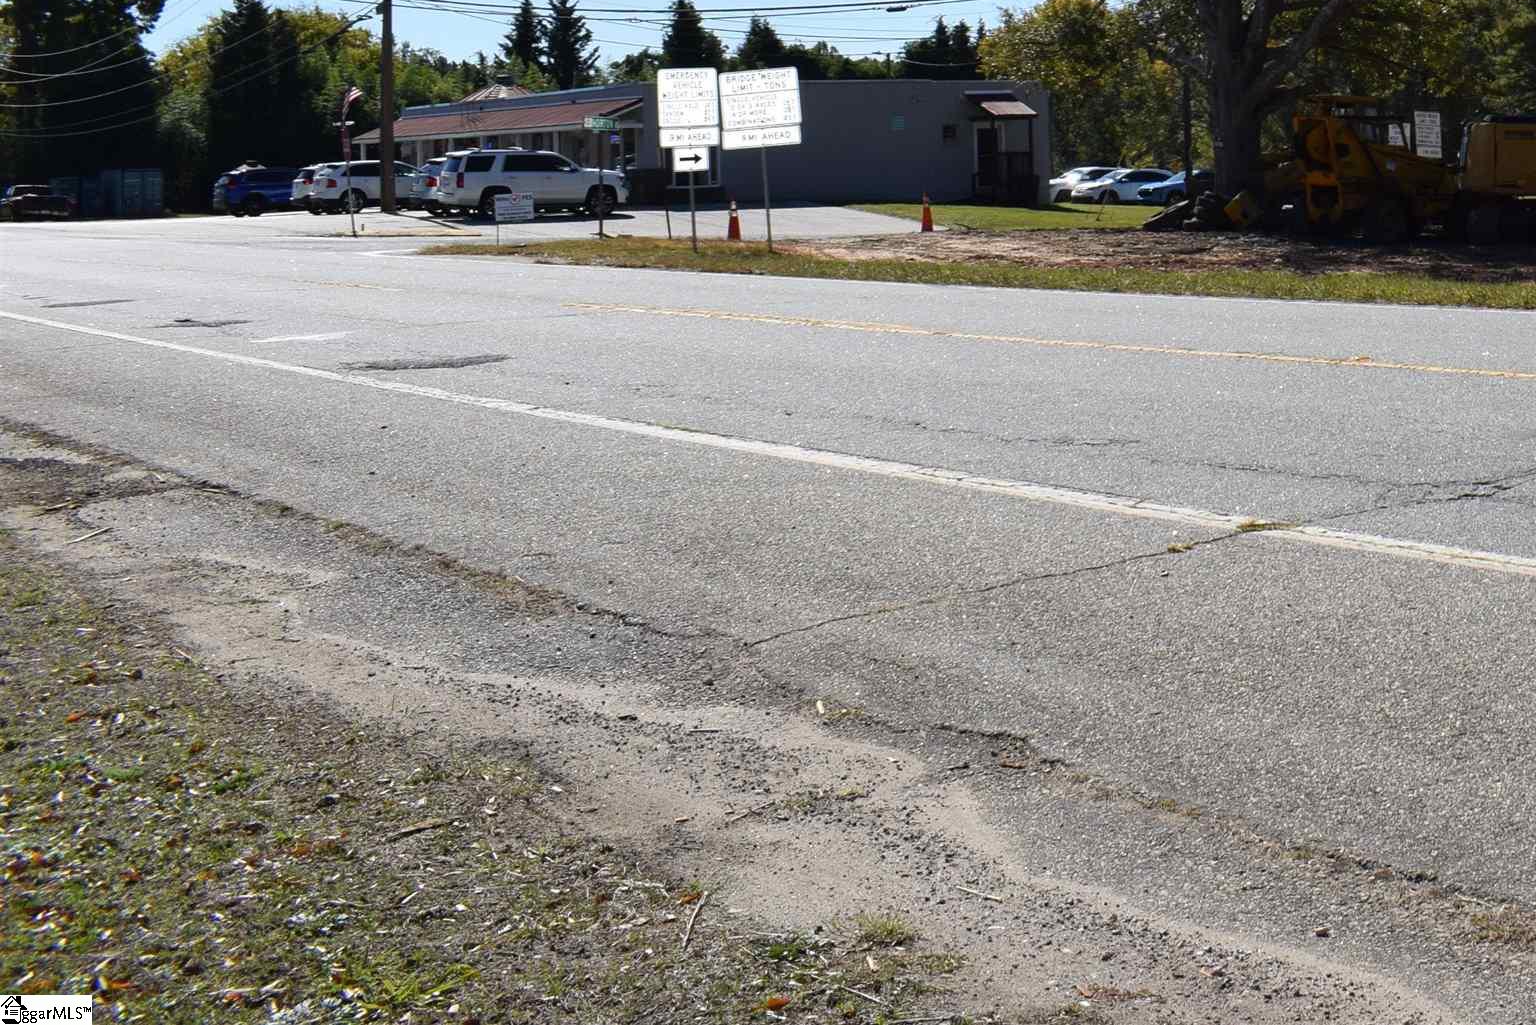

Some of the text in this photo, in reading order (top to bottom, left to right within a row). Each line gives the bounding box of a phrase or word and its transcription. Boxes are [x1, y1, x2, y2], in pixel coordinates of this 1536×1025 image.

[664, 71, 709, 80] EMERGENCY
[725, 70, 792, 83] BRIDGE WEIGHT
[673, 81, 703, 89] VEHICLE
[731, 83, 753, 92] LIMIT
[764, 81, 787, 89] TONS
[688, 132, 712, 141] AHEAD
[761, 131, 791, 140] AHEAD
